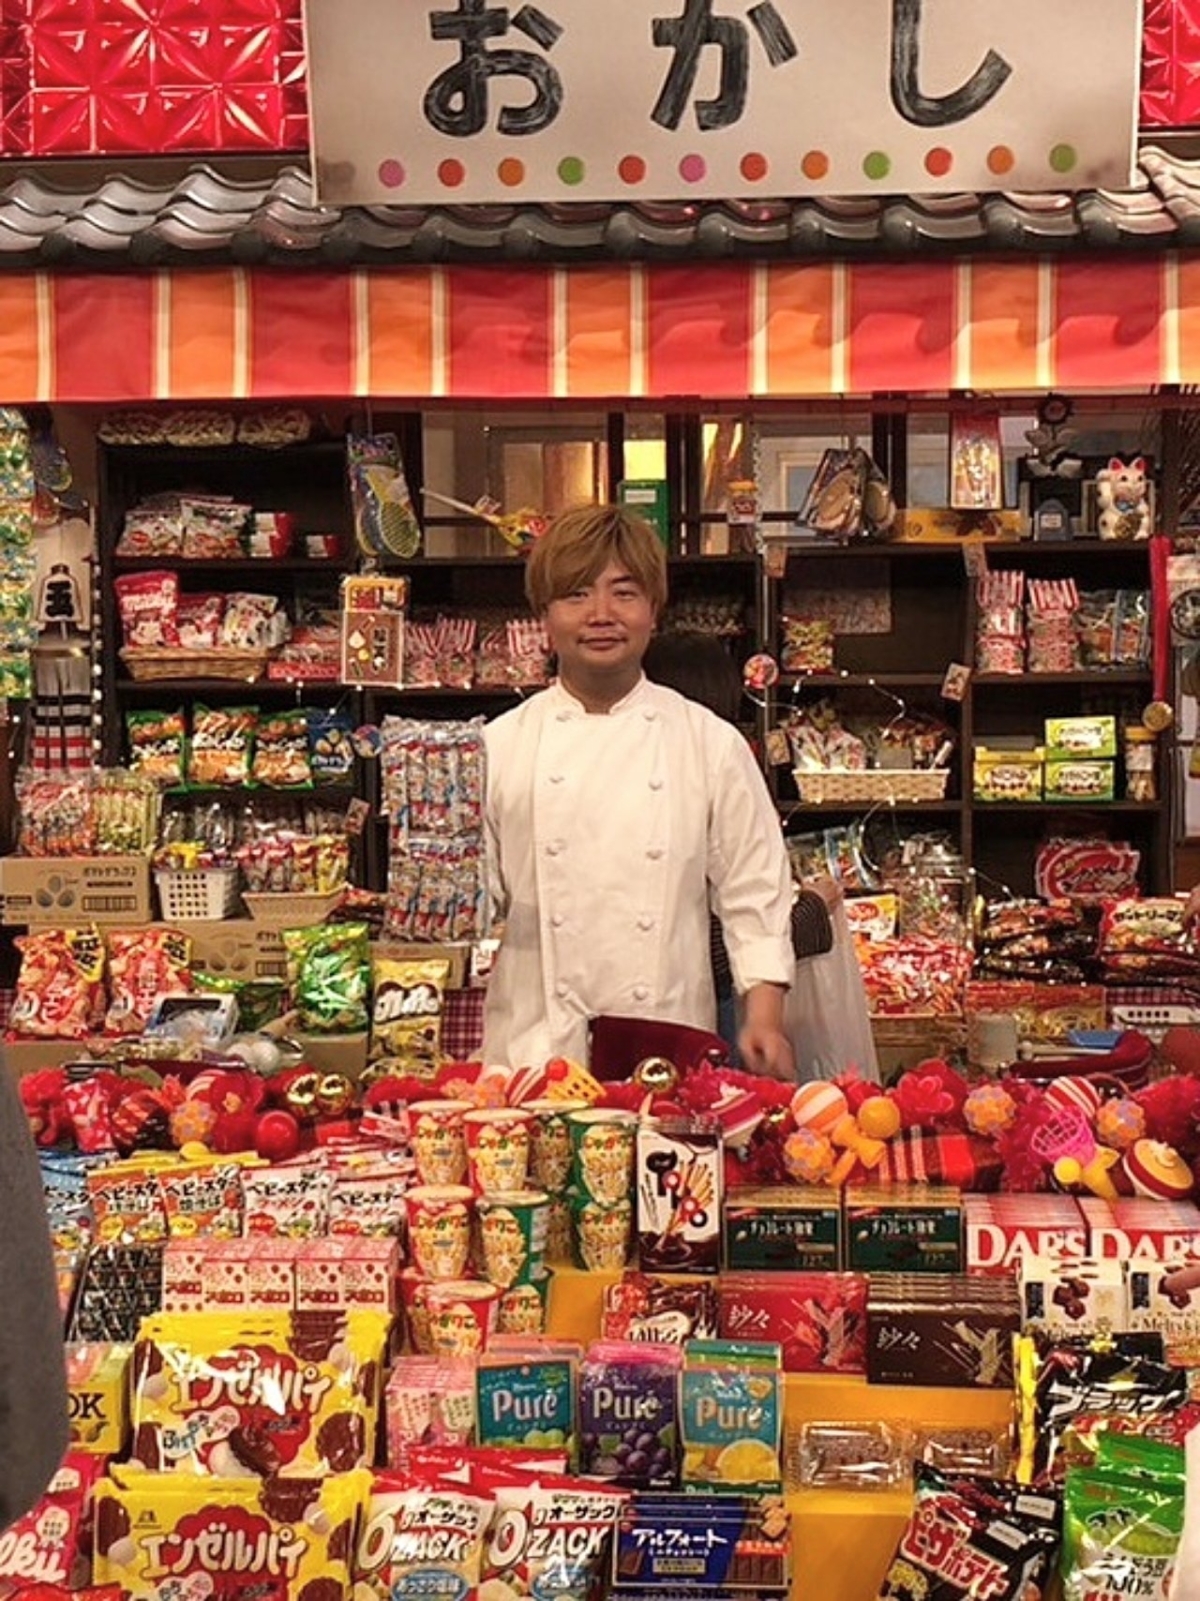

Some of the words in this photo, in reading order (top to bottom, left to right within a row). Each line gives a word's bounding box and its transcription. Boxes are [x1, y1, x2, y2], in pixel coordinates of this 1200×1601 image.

[423, 0, 1013, 137] おかし
[967, 1224, 1087, 1268] DARS
[140, 1522, 309, 1580] エンゼルパイ
[632, 1528, 729, 1549] アルフォート
